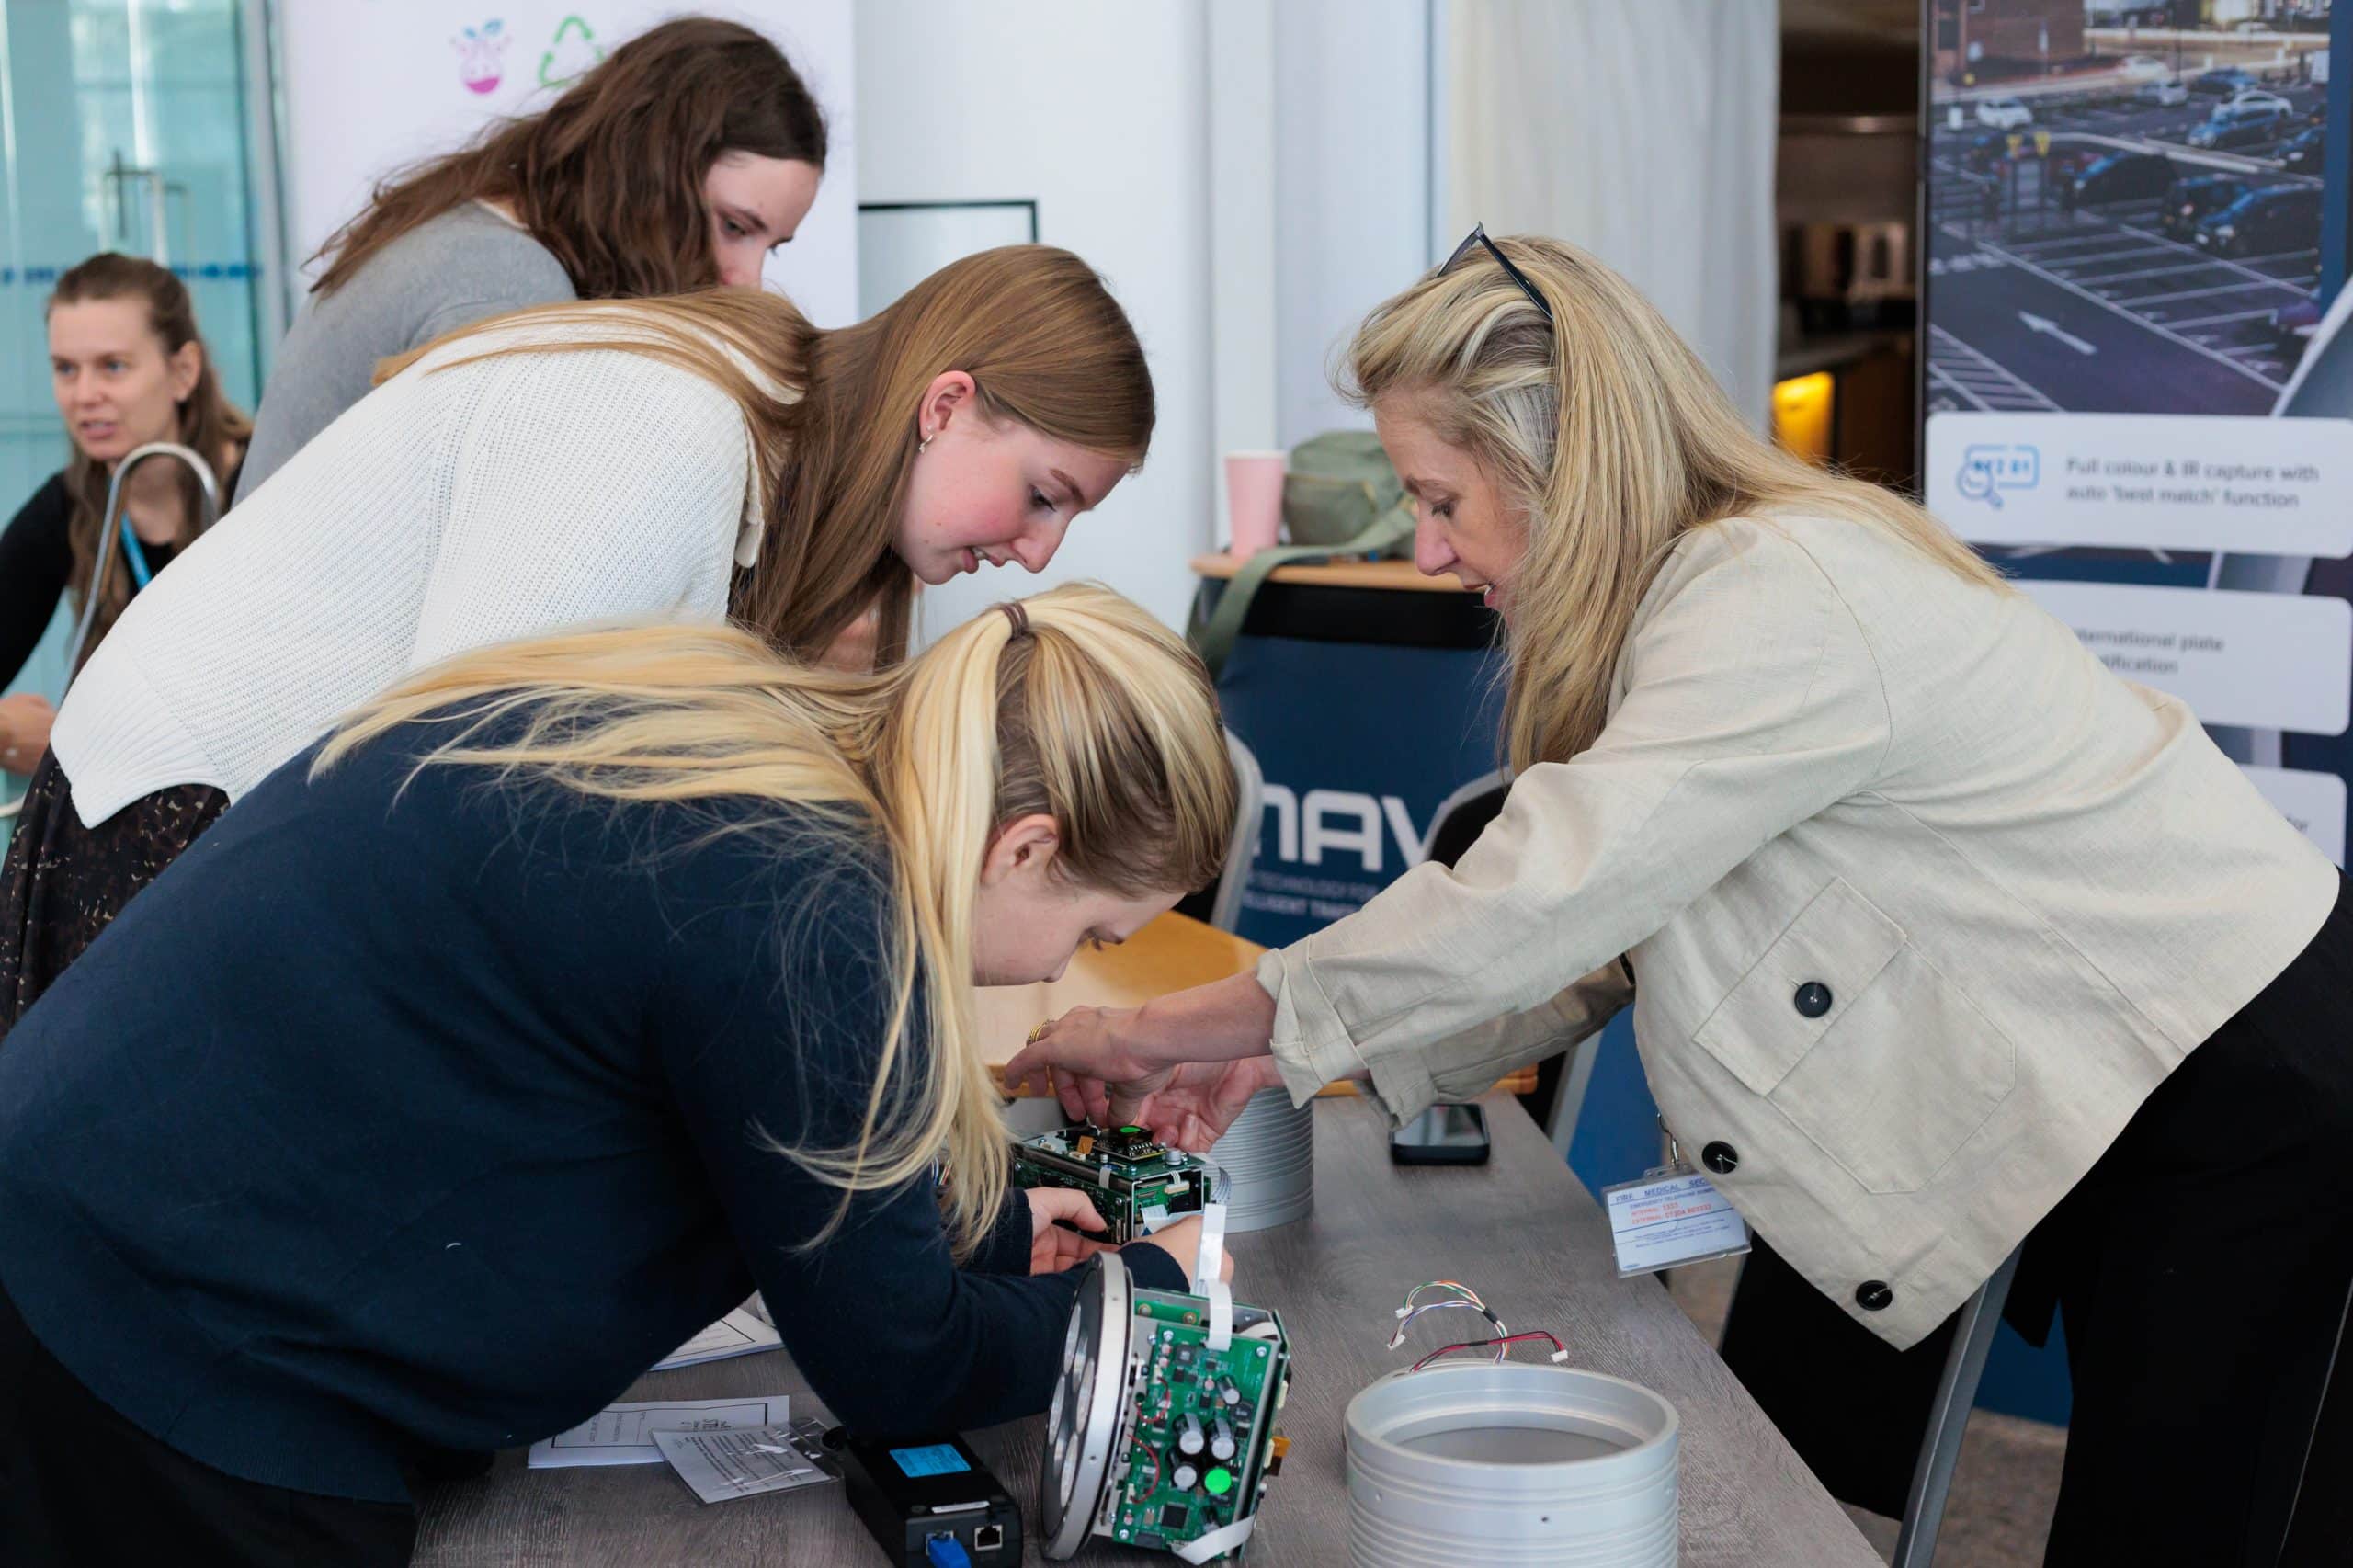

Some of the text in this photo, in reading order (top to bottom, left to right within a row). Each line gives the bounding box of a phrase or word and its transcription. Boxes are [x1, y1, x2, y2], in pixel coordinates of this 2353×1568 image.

[2067, 458, 2320, 483] Full colour & IR capture with
[2067, 485, 2106, 501] auto
[2224, 488, 2300, 508] function
[2074, 628, 2224, 653] nternational plate
[2099, 654, 2178, 673] tification
[1242, 890, 1307, 915] LLIGENT
[1616, 1177, 1708, 1202] FIRE MEDICAL SEC
